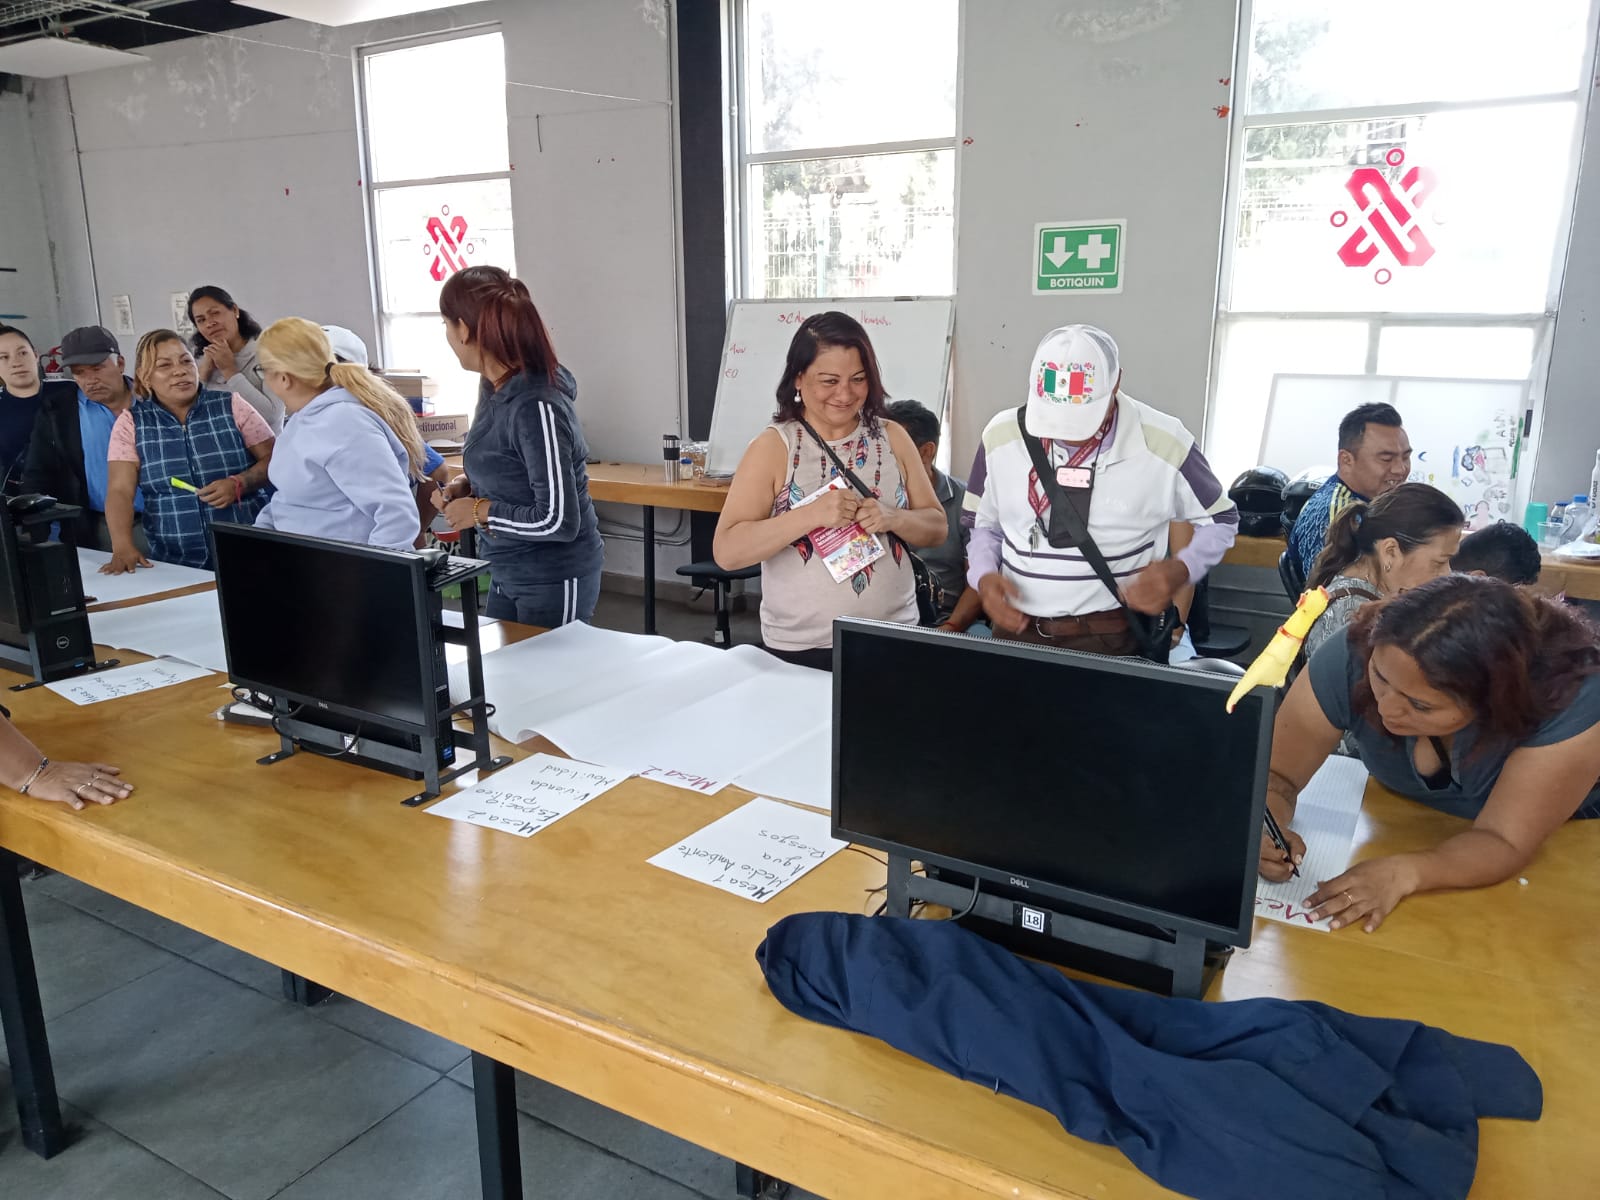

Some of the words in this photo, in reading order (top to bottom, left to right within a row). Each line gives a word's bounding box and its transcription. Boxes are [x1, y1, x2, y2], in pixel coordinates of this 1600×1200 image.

[1050, 277, 1104, 288] BOTIQUIN
[417, 419, 457, 432] stitucional
[664, 770, 718, 791] Mesa
[467, 809, 487, 820] 2
[485, 799, 560, 822] Espacio
[488, 815, 542, 834] Mesa
[758, 829, 826, 859] Riesgos
[762, 852, 806, 877] Agua
[712, 873, 725, 884] 1
[741, 864, 789, 888] Medio
[1010, 877, 1029, 889] DELL
[730, 876, 774, 900] Mesa
[1026, 914, 1040, 926] 18
